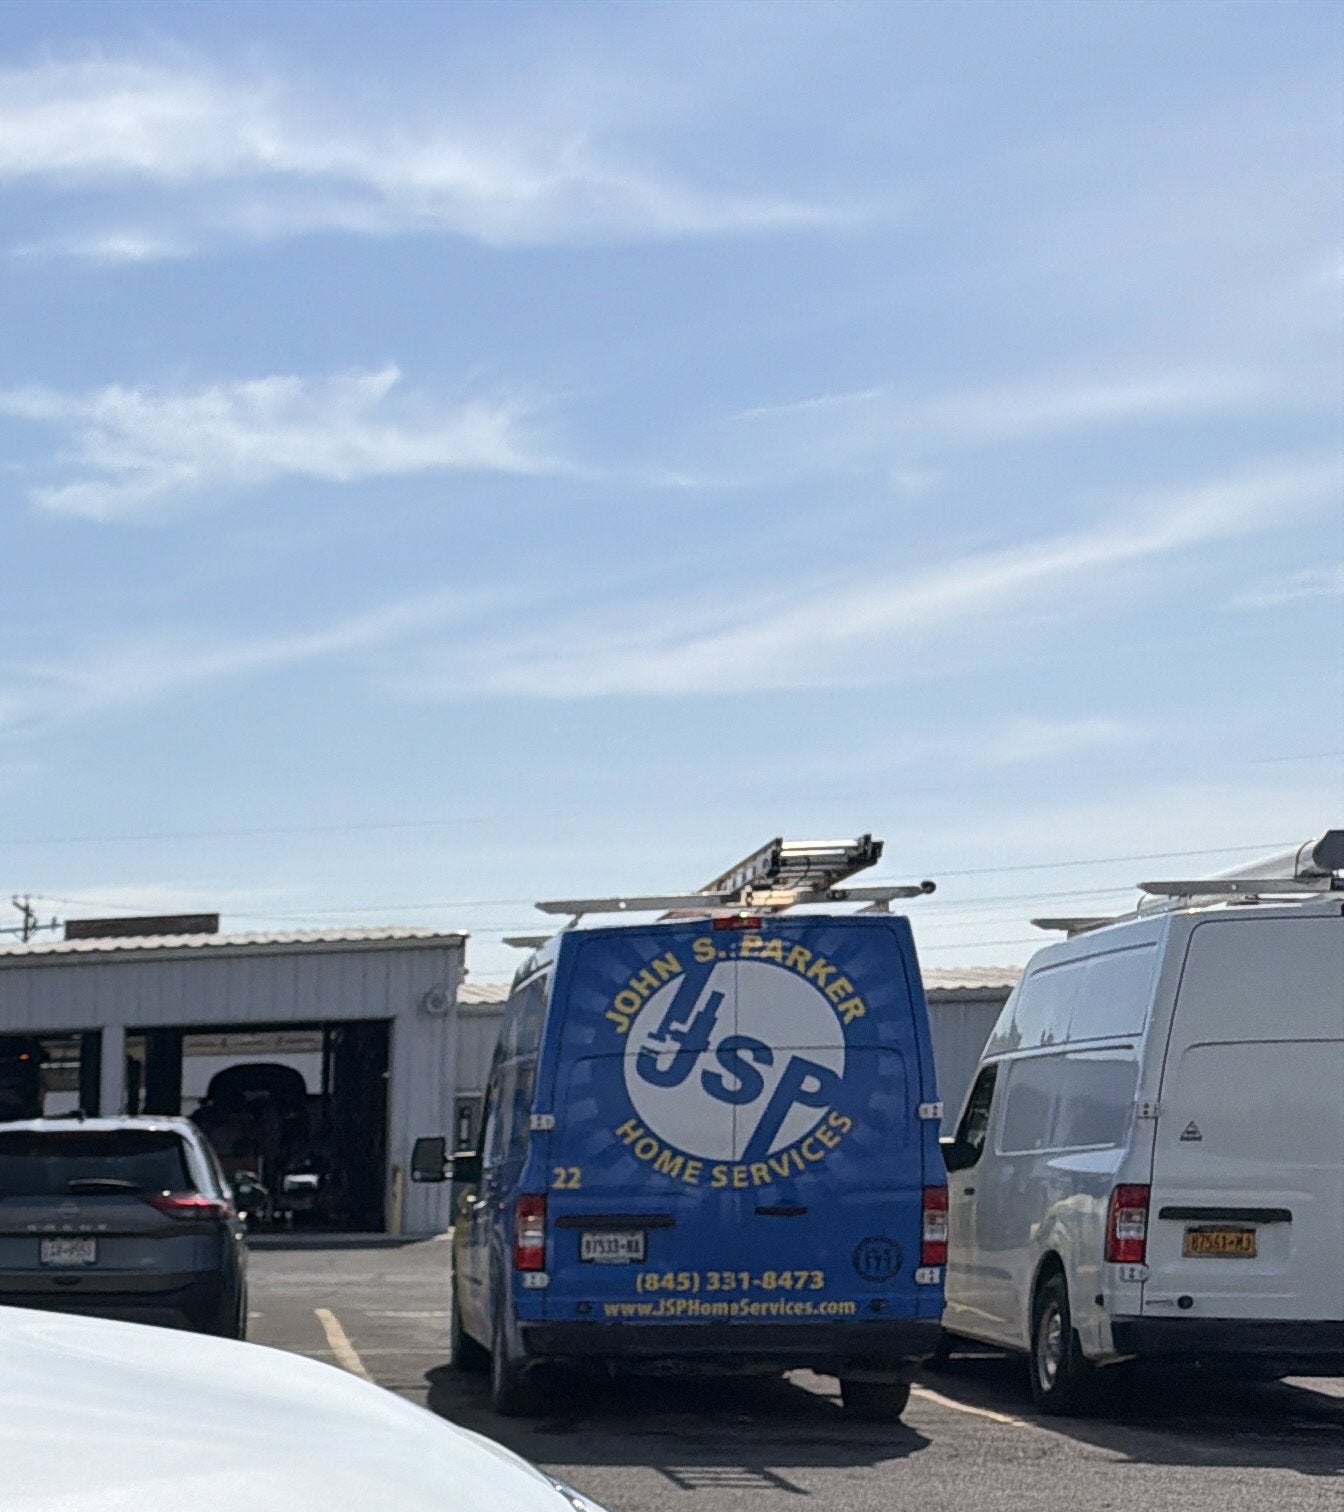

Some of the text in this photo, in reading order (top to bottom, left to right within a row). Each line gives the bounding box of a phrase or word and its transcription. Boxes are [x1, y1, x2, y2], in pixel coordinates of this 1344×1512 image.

[605, 934, 867, 1034] JOHN S. PARKER
[634, 963, 845, 1162] JSP
[615, 1110, 853, 1189] HOME SERVICES
[551, 1166, 583, 1190] 22
[603, 1297, 857, 1317] www.JSPHomeServices.com
[636, 1270, 825, 1293] (845) 331-8473
